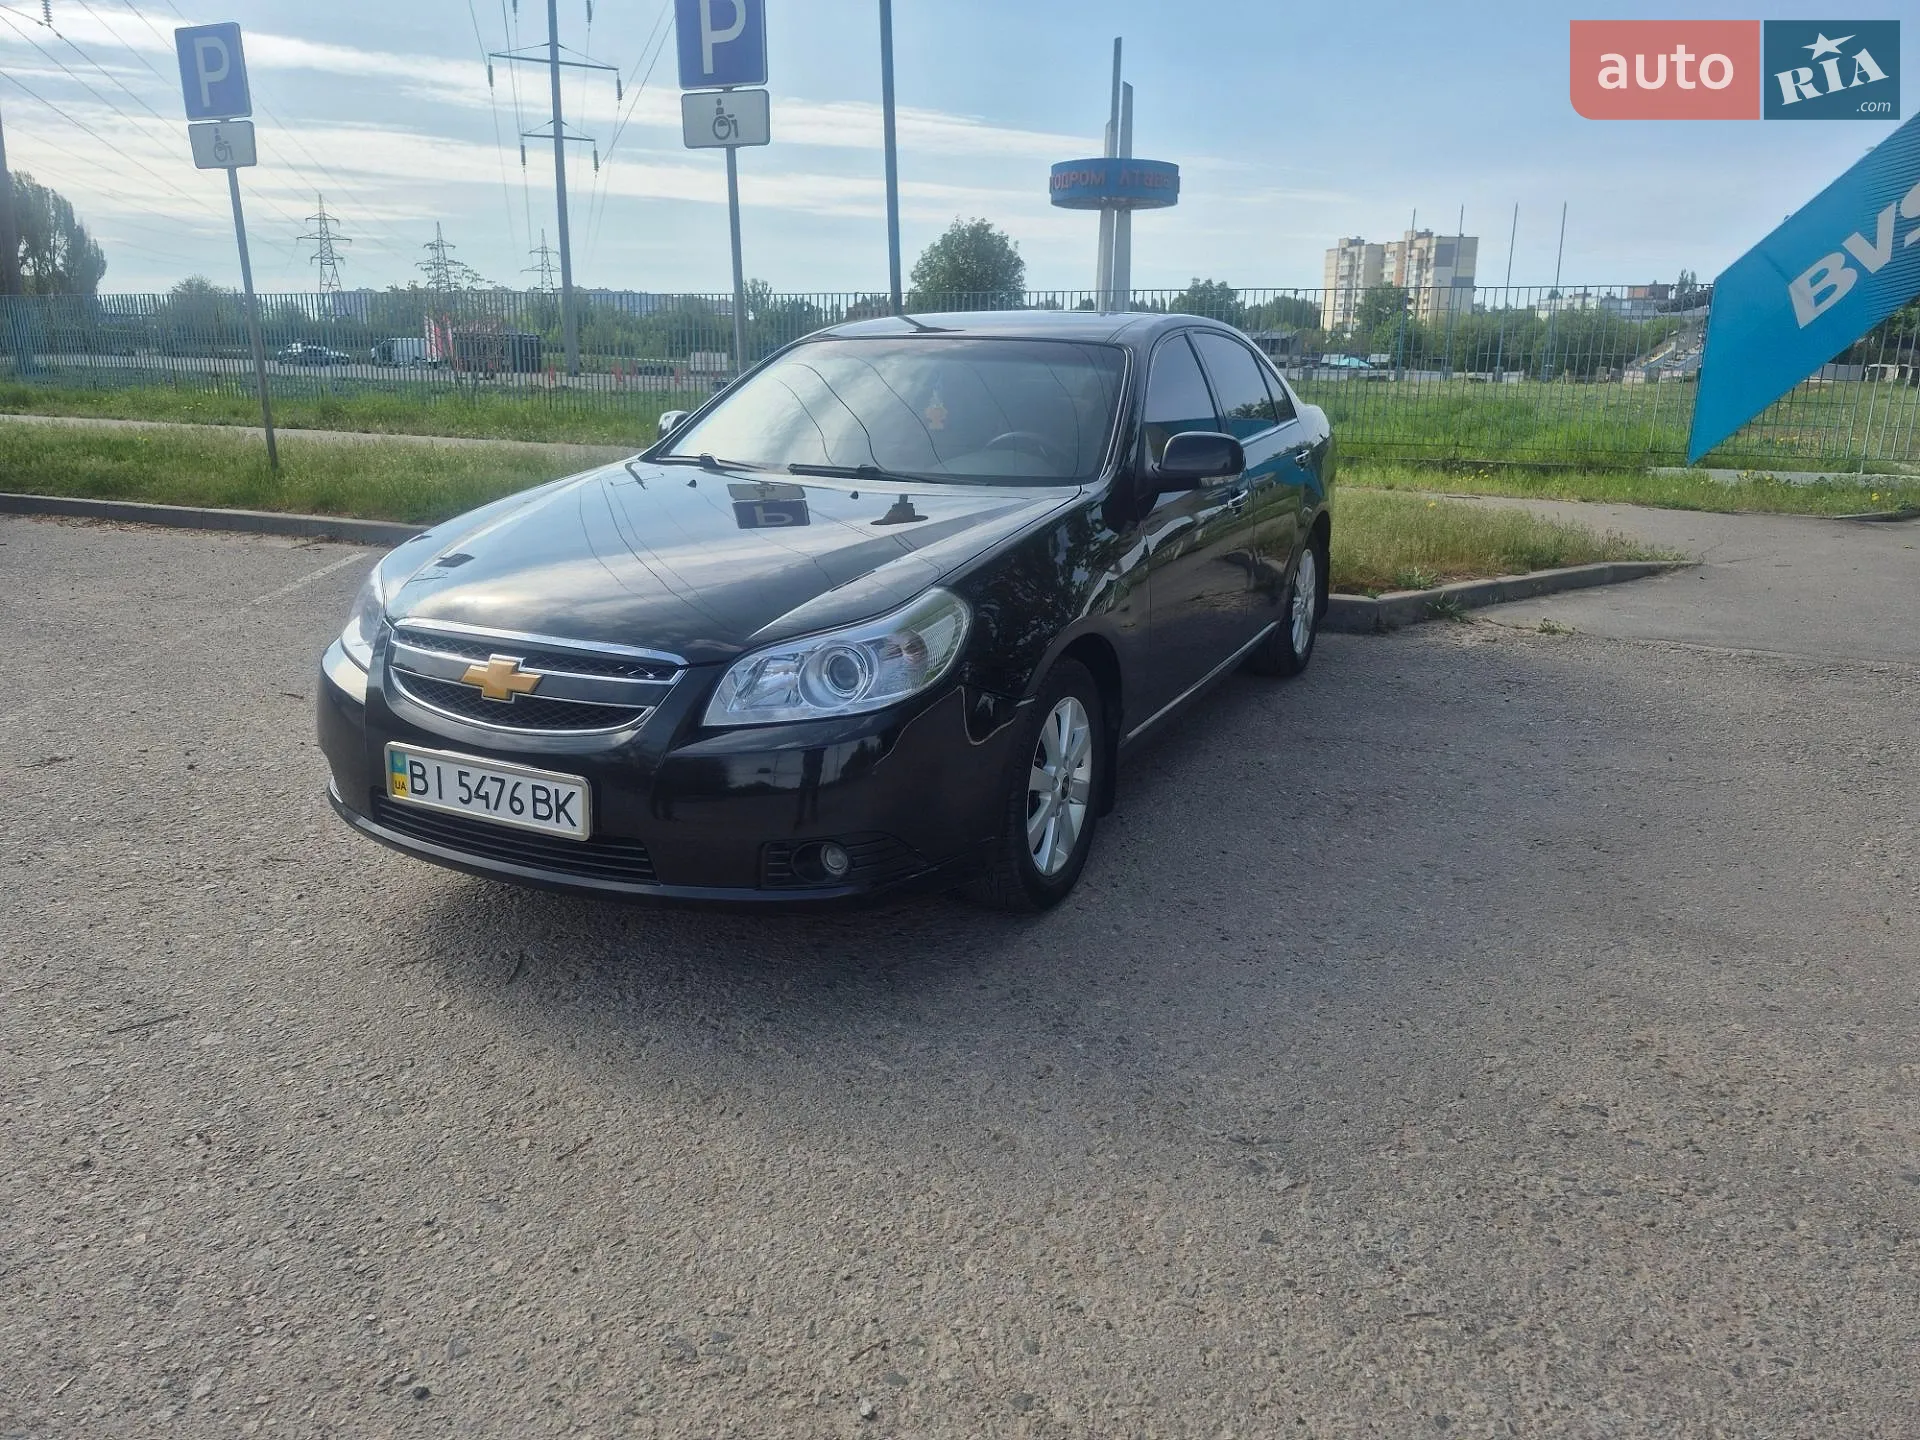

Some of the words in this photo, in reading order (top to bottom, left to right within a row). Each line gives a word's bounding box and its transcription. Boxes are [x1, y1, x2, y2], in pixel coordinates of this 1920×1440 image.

[700, 0, 747, 74] P
[194, 36, 230, 108] P
[394, 779, 407, 791] UA
[409, 760, 443, 800] BI
[457, 770, 525, 815] 5476
[531, 784, 577, 827] BK
